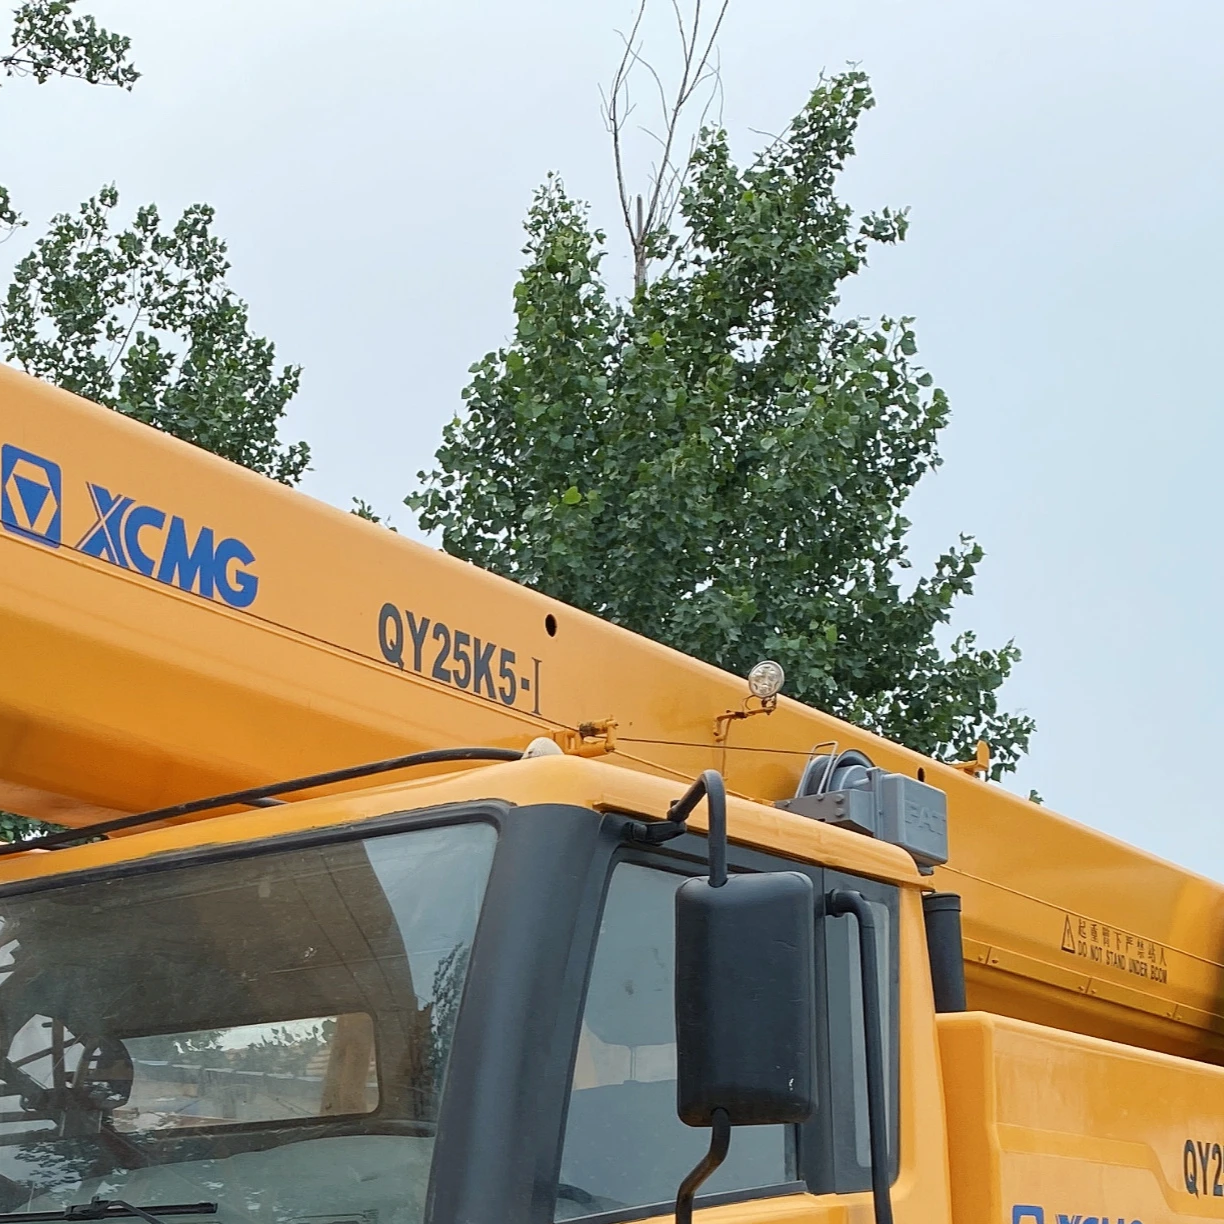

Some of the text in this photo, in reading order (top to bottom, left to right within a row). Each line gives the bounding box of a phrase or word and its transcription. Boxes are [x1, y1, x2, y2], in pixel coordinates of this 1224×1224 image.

[75, 481, 259, 608] XCMG
[1078, 940, 1088, 958] DO
[1090, 945, 1103, 963] NOT
[1106, 950, 1126, 971] STAND
[1128, 958, 1148, 979] UNDER
[1183, 1139, 1224, 1199] QY2
